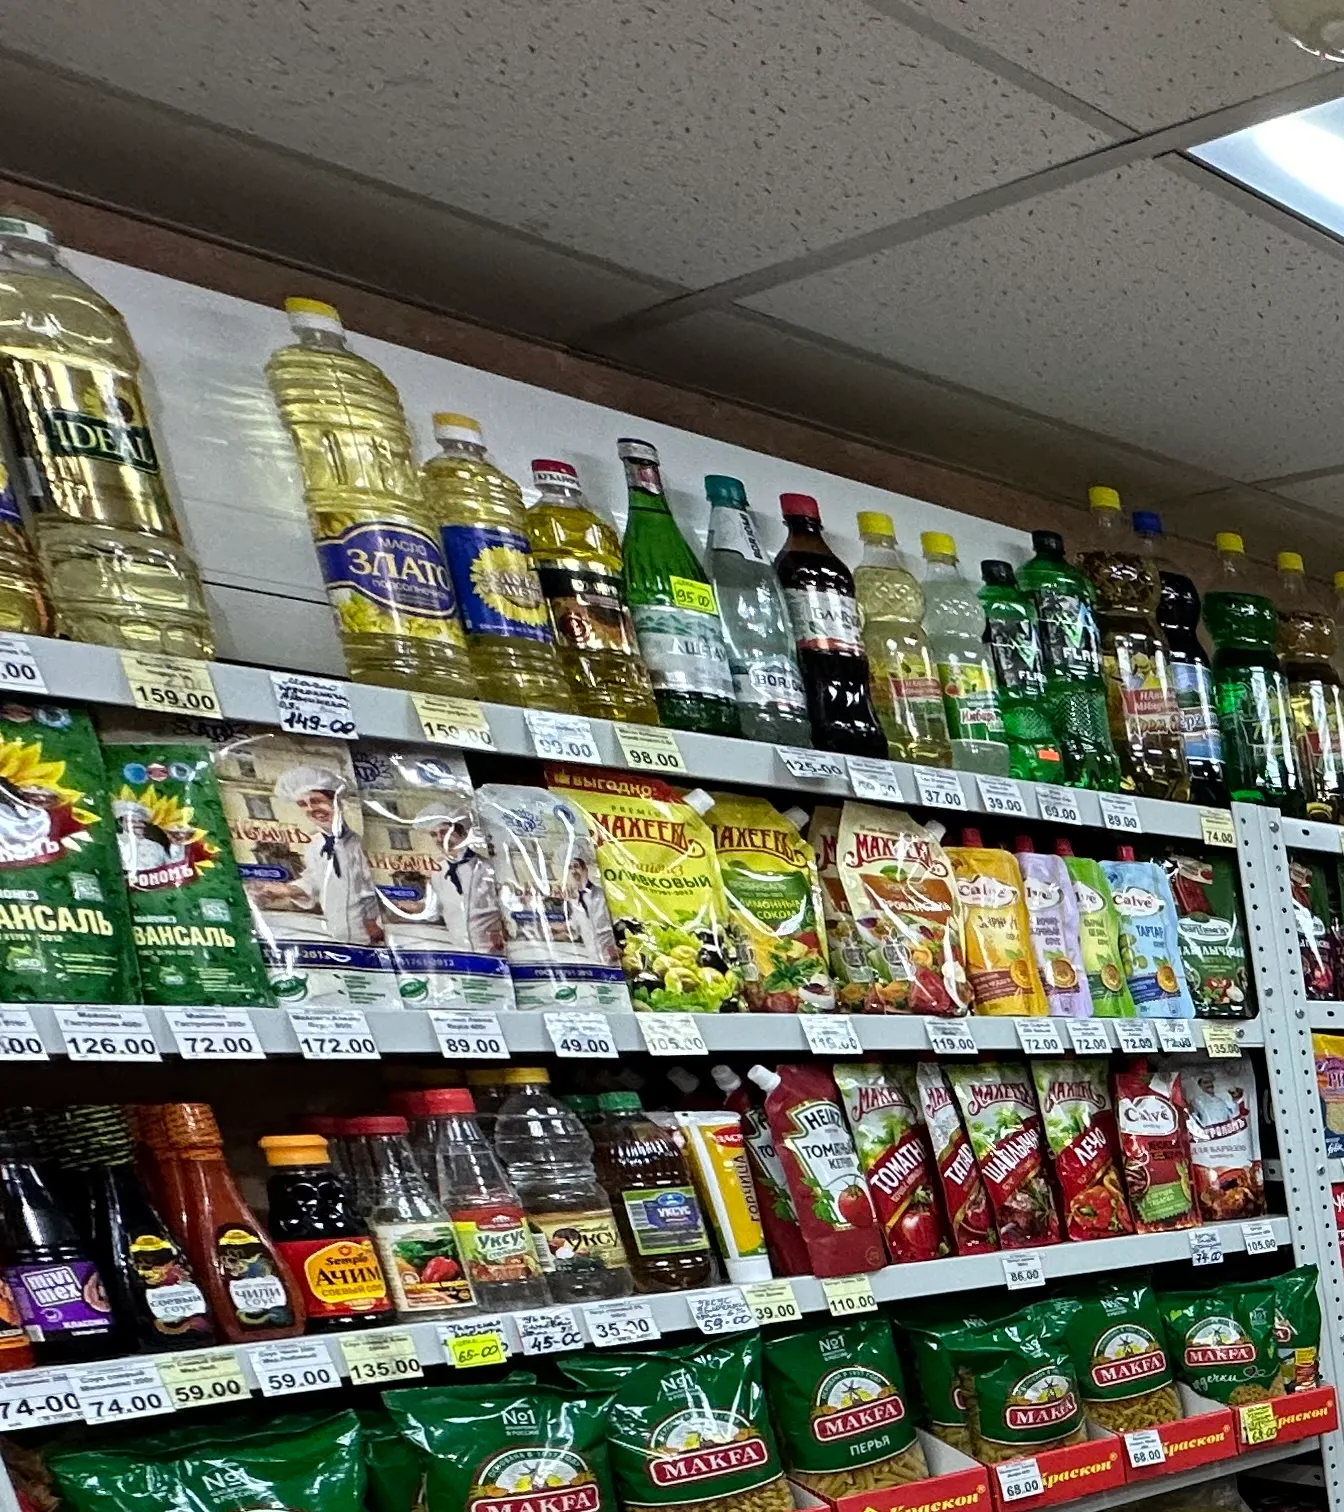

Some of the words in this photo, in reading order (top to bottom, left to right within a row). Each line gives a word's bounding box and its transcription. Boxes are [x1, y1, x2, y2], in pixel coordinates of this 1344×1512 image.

[53, 408, 155, 470] IDEAL
[379, 538, 426, 558] МАСЛО
[137, 684, 215, 711] 159.00
[629, 750, 679, 768] 98.00
[924, 790, 961, 807] 37.00
[604, 868, 713, 890] ОЛИВКОВЫЙ
[67, 1037, 156, 1055] 126.00
[185, 1037, 254, 1054] 72.00
[301, 1037, 376, 1055] 172.00
[446, 1038, 501, 1054] 89.00
[560, 1038, 610, 1054] 49.00
[932, 1036, 973, 1049] 119.00
[316, 1264, 381, 1288] АЧИМ
[755, 1304, 796, 1319] 39.00
[830, 1295, 876, 1312] 110.00
[350, 1358, 420, 1380] 135.00
[1099, 1355, 1163, 1382] MAKFA
[268, 1368, 331, 1391] 59.00
[175, 1380, 241, 1402] 59.00
[90, 1394, 163, 1416] 74.00
[823, 1402, 899, 1436] MAKFA
[850, 1434, 891, 1457] ПЕРЬЯ
[664, 1444, 761, 1482] MAKFA
[1007, 1479, 1038, 1497] 68.00
